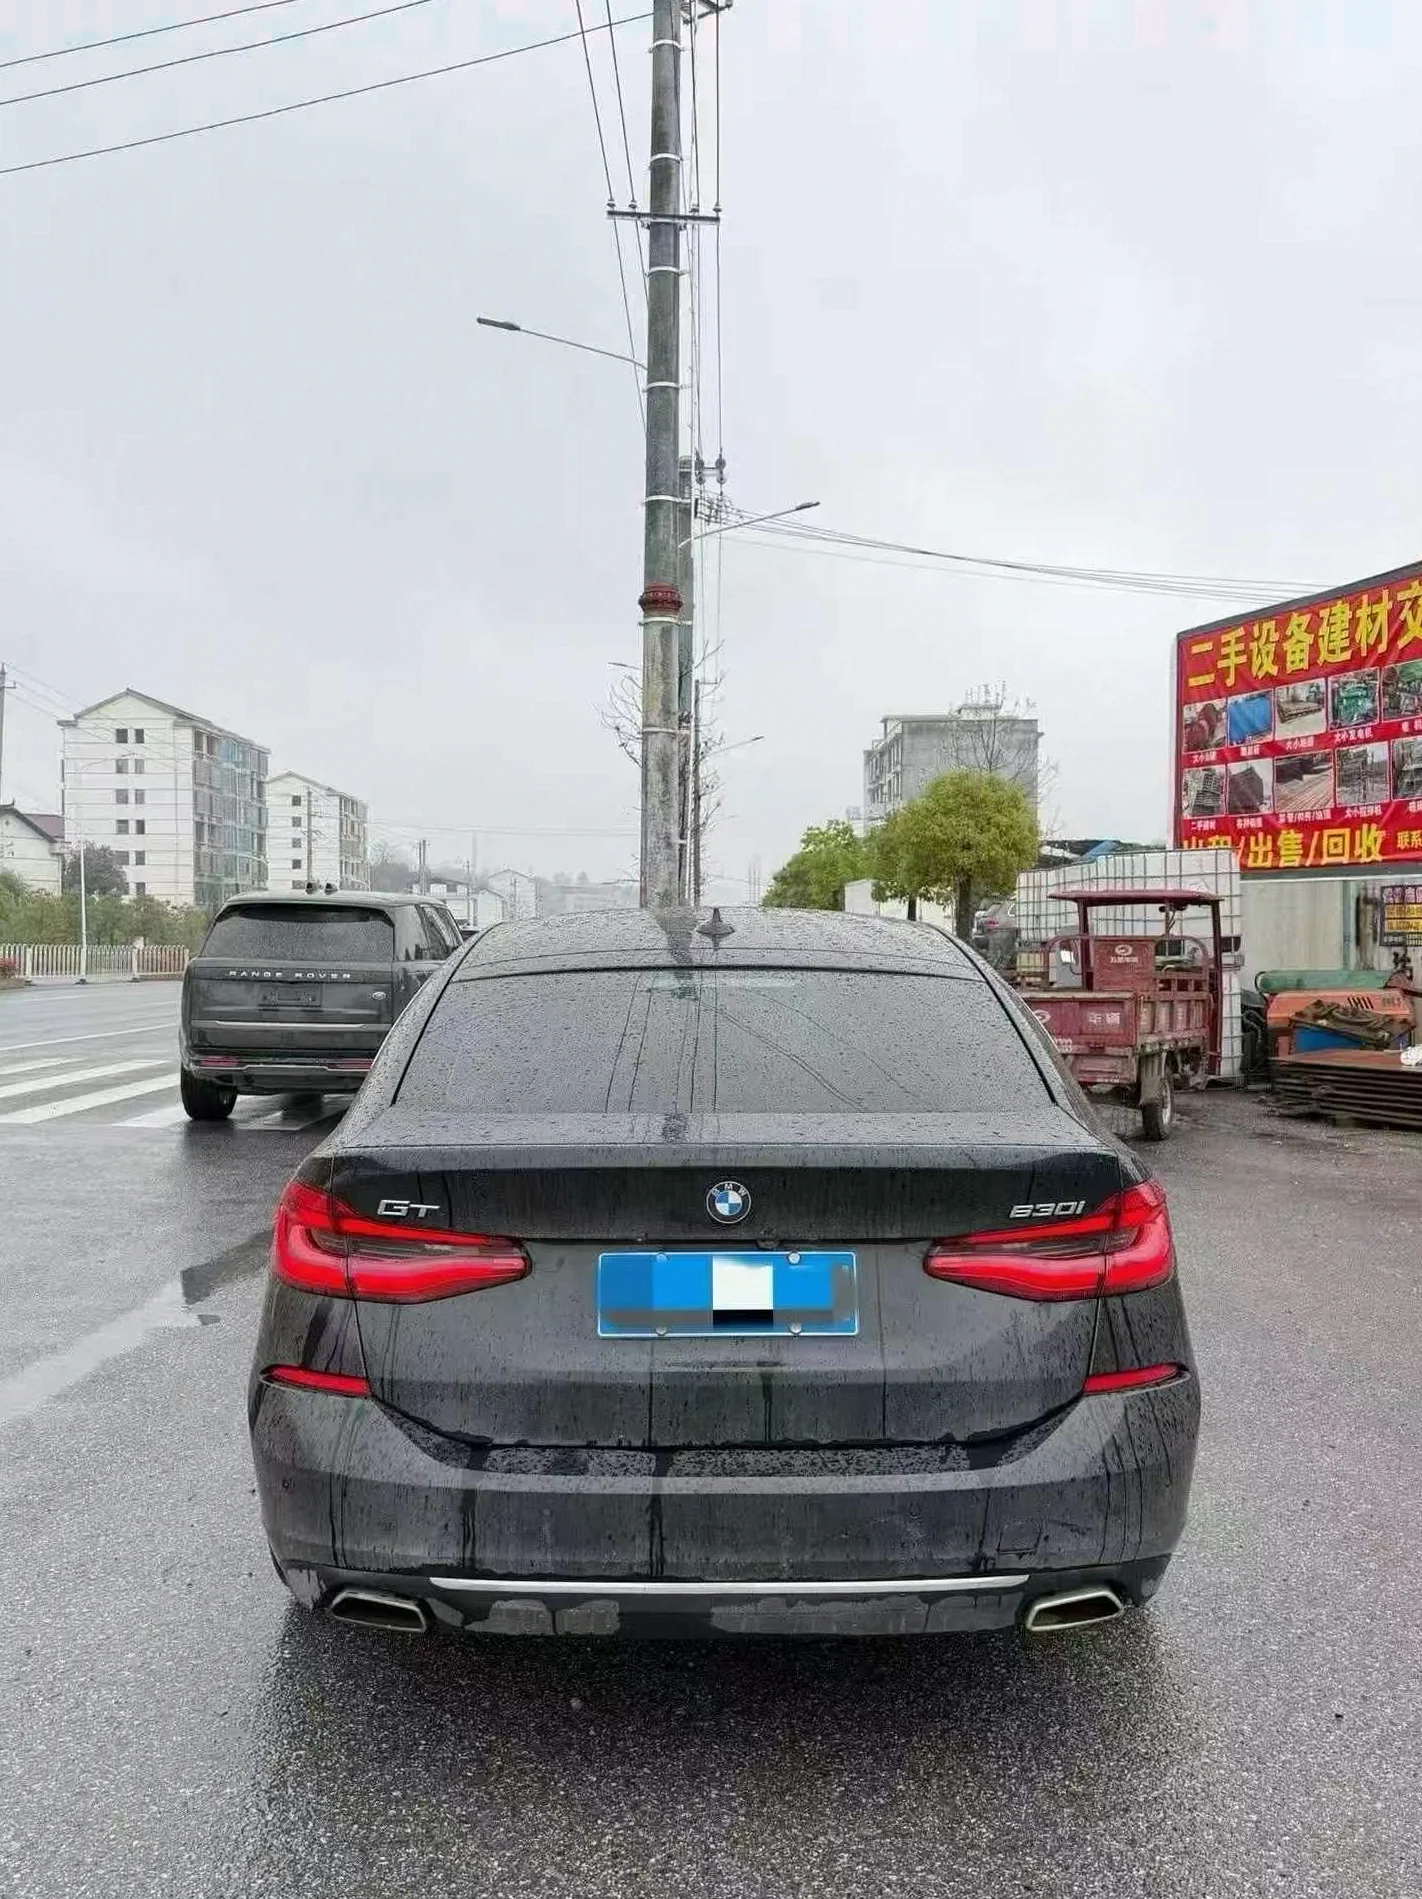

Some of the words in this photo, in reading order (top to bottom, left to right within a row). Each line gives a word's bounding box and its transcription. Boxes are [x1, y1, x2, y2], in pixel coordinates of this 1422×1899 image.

[228, 970, 284, 979] RANGE
[295, 972, 353, 980] ROVER
[376, 1199, 442, 1218] GT
[1008, 1200, 1086, 1219] 630i
